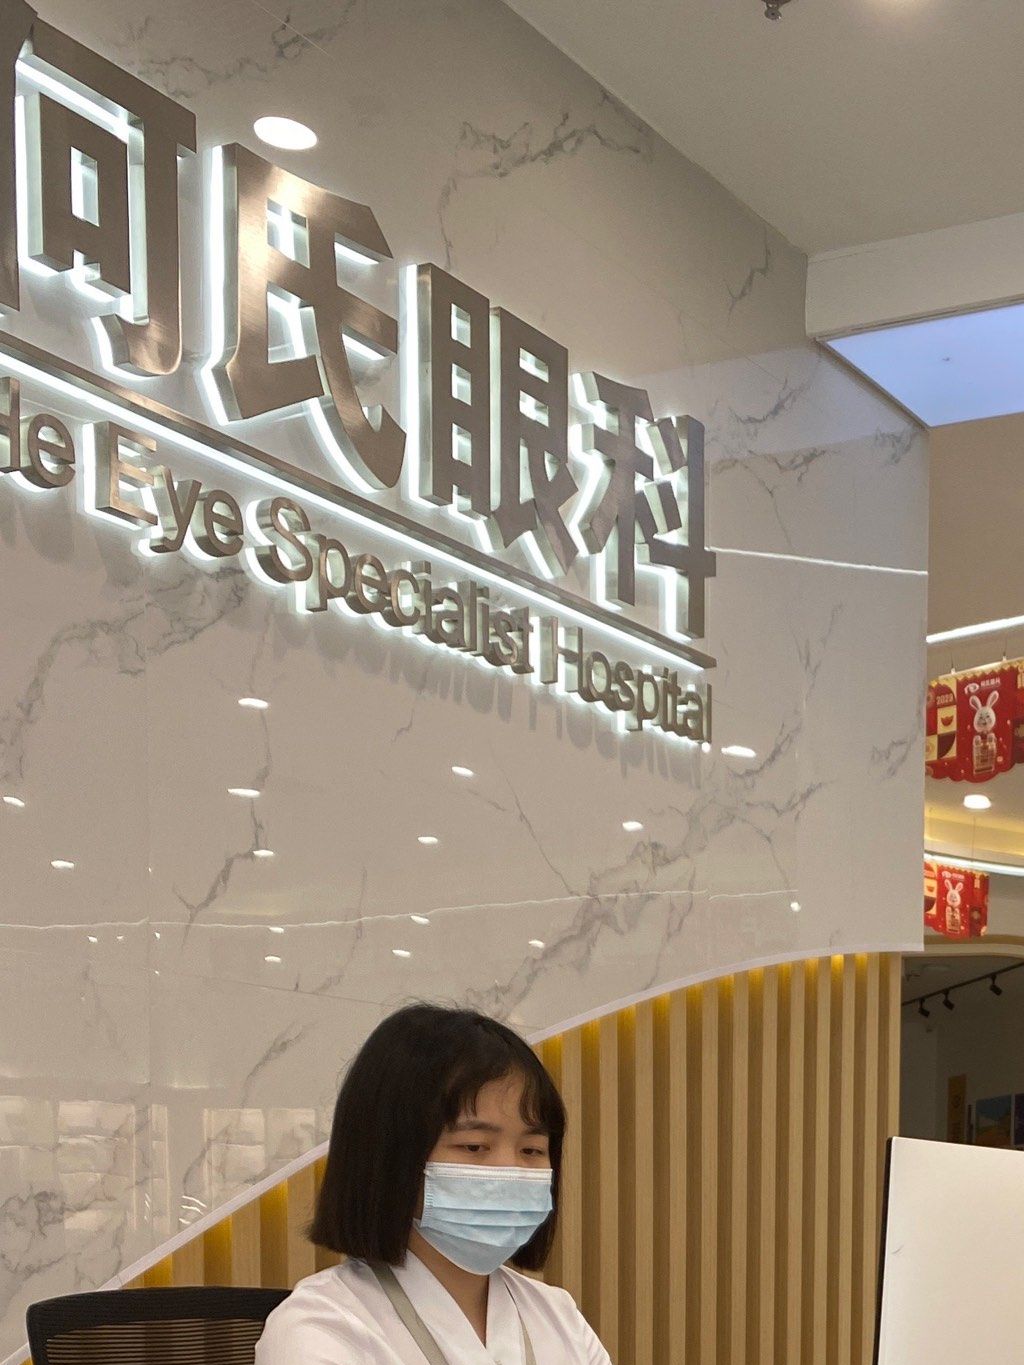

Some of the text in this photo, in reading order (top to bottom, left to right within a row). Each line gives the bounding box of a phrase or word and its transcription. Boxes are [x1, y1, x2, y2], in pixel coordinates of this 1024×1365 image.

[0, 0, 716, 640] 何氏眼科
[96, 420, 244, 558] Eye
[254, 496, 535, 675] Specialist
[540, 615, 713, 745] Hospital
